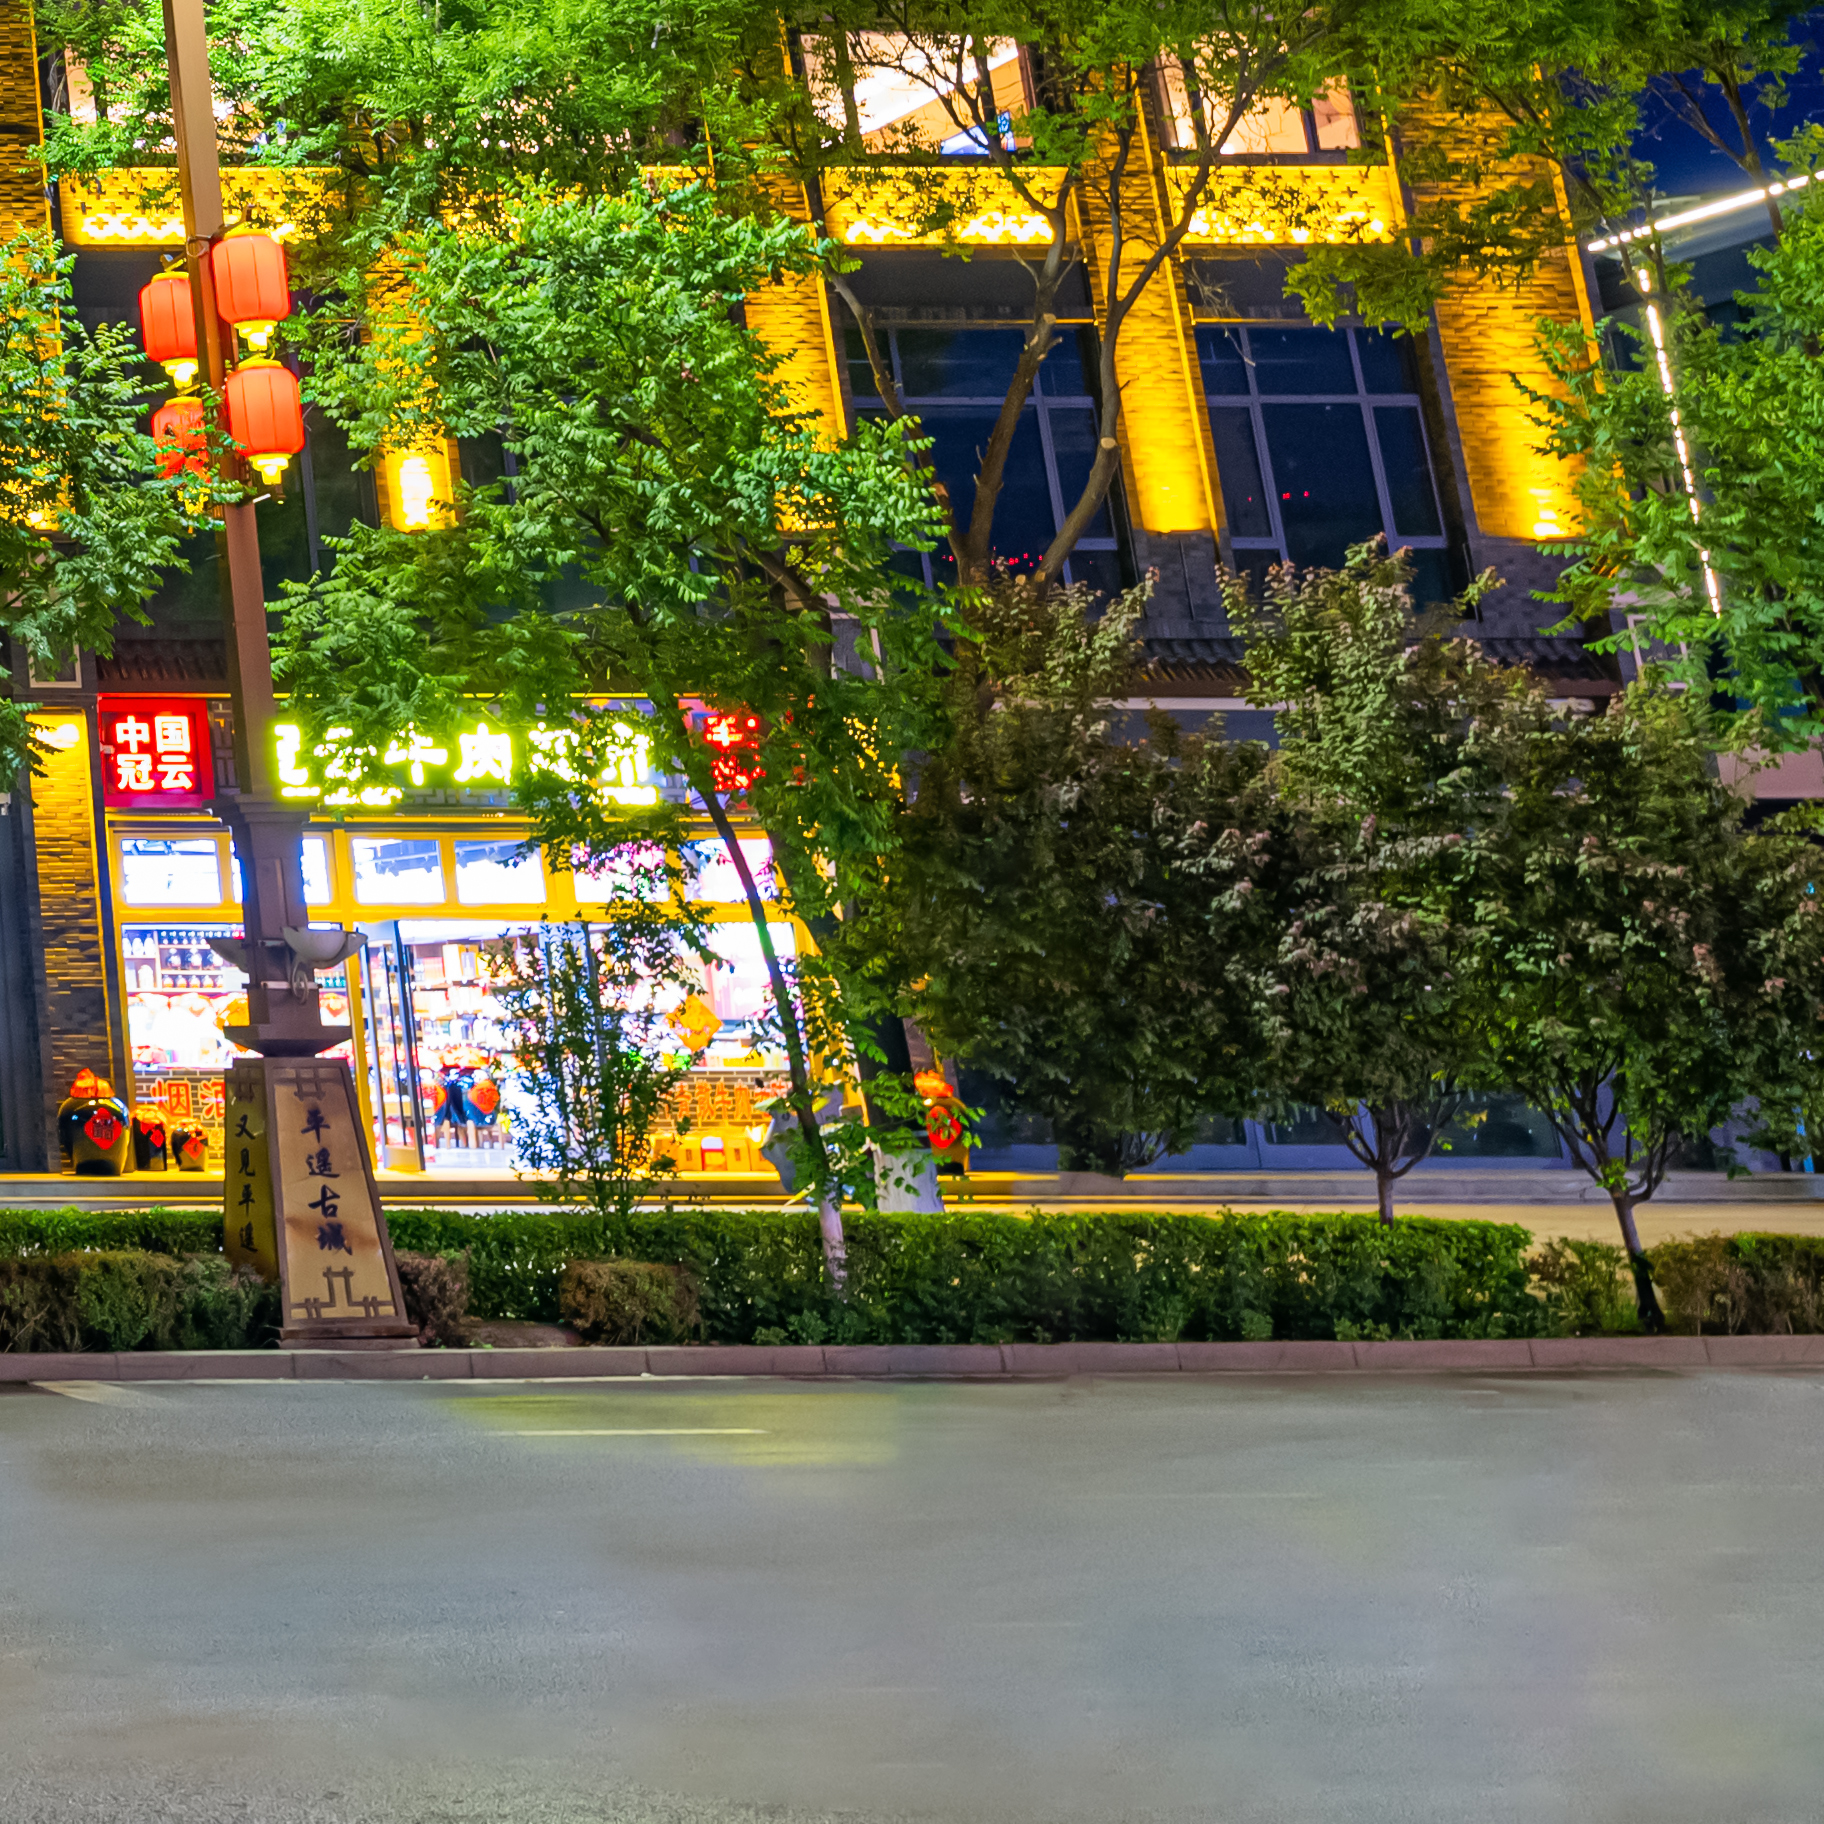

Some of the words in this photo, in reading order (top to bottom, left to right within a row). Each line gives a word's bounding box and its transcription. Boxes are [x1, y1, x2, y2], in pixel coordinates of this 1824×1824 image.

[115, 715, 191, 754] 中国
[116, 753, 194, 791] 冠云
[234, 1114, 259, 1253] 又见平遥
[300, 1107, 353, 1255] 平遥古城
